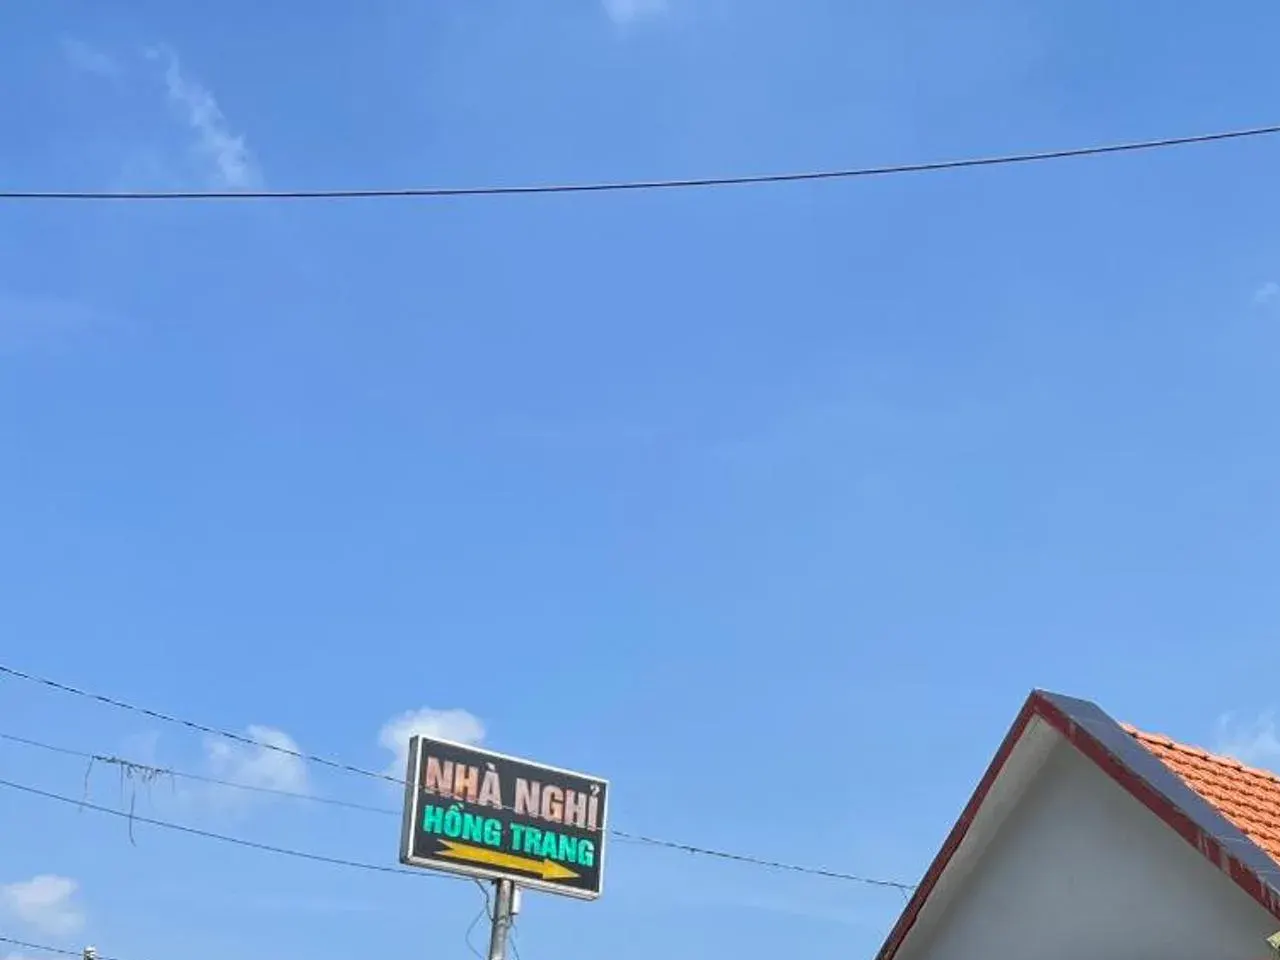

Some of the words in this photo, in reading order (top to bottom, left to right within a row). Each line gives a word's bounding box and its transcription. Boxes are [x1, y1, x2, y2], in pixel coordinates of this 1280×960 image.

[425, 756, 502, 809] NHÀ
[514, 777, 600, 832] NGHỈ
[423, 802, 502, 847] HỒNG
[510, 822, 595, 867] TRANG
